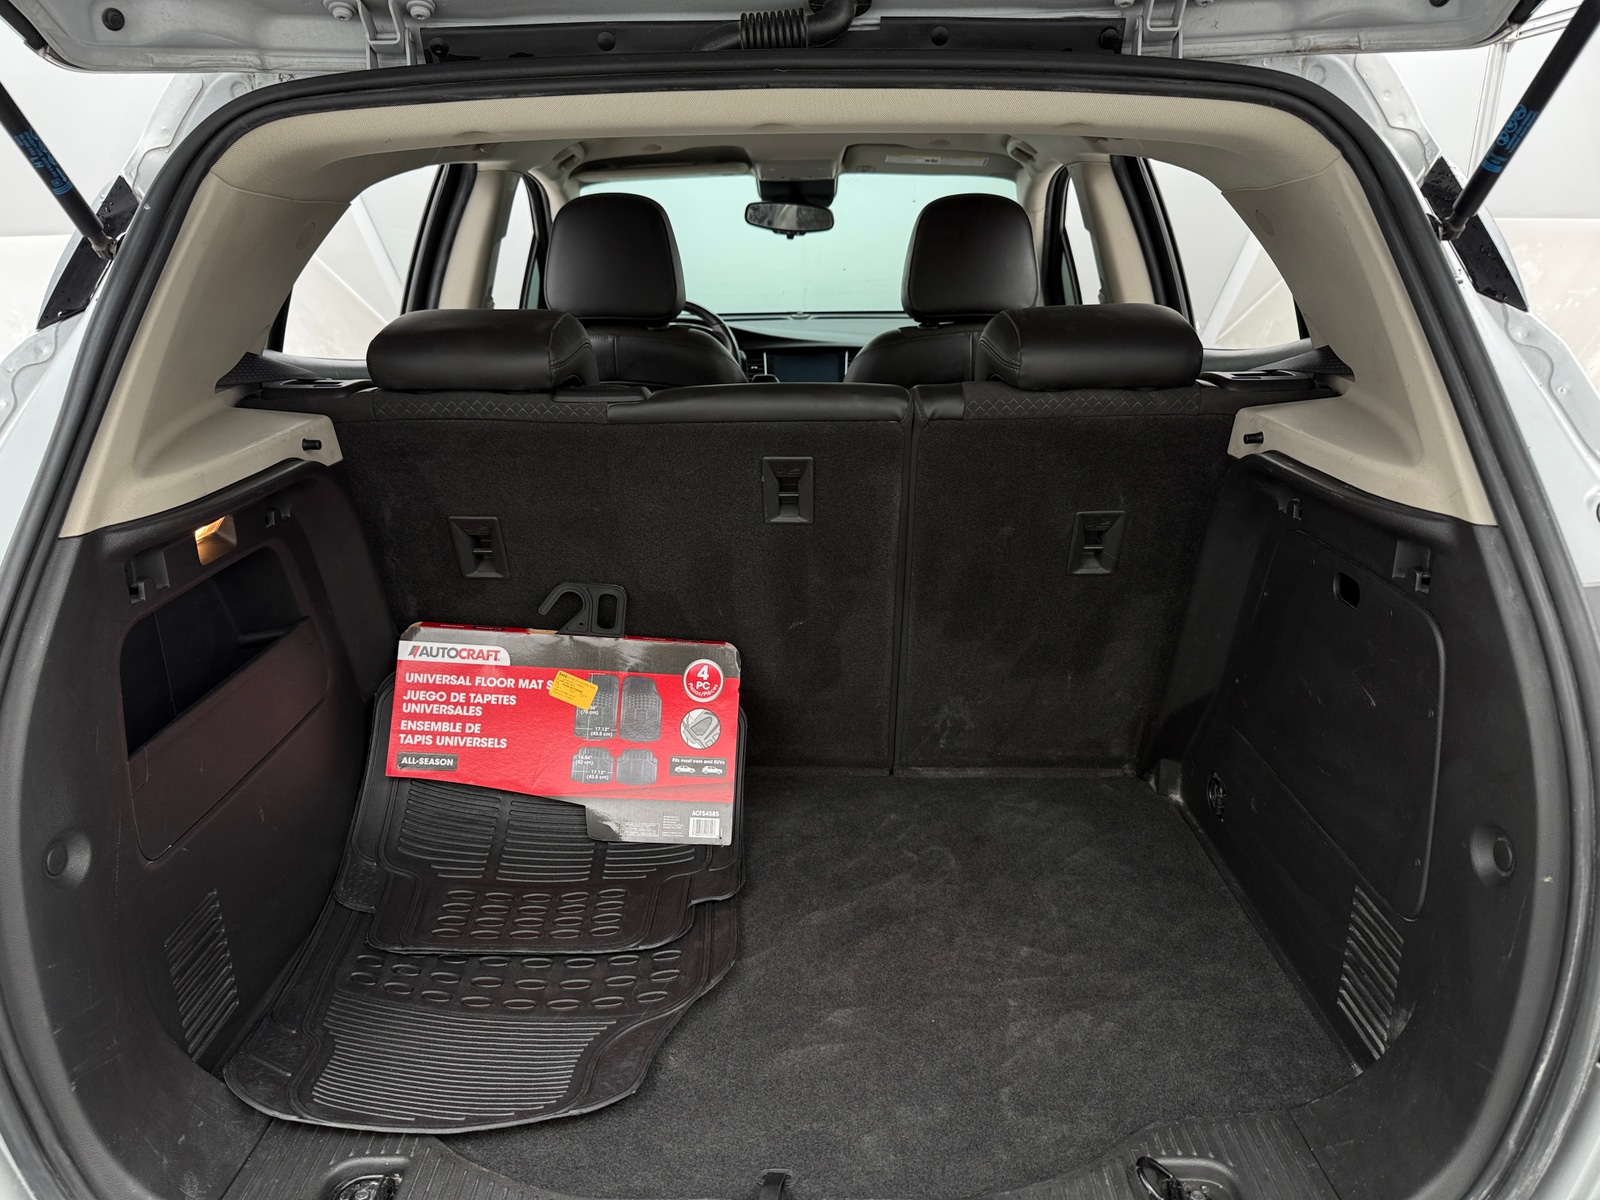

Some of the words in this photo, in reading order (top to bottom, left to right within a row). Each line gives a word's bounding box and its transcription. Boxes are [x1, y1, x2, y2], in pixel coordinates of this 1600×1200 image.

[418, 646, 501, 661] AUTOCRAFT
[697, 665, 710, 680] 4
[405, 673, 471, 686] UNIVERSAL
[475, 676, 515, 689] FLOOR
[518, 679, 544, 690] MAT
[695, 681, 710, 690] PC
[403, 690, 447, 702] JUEGO
[450, 692, 466, 703] DE
[469, 693, 517, 705] TAPETES
[402, 703, 483, 716] UNIVERSALES
[400, 720, 462, 733] ENSEMBLE
[465, 723, 481, 734] DE
[399, 734, 433, 746] TAPIS
[436, 735, 507, 748] UNIVERSELS
[401, 757, 454, 766] ALL-SEASON
